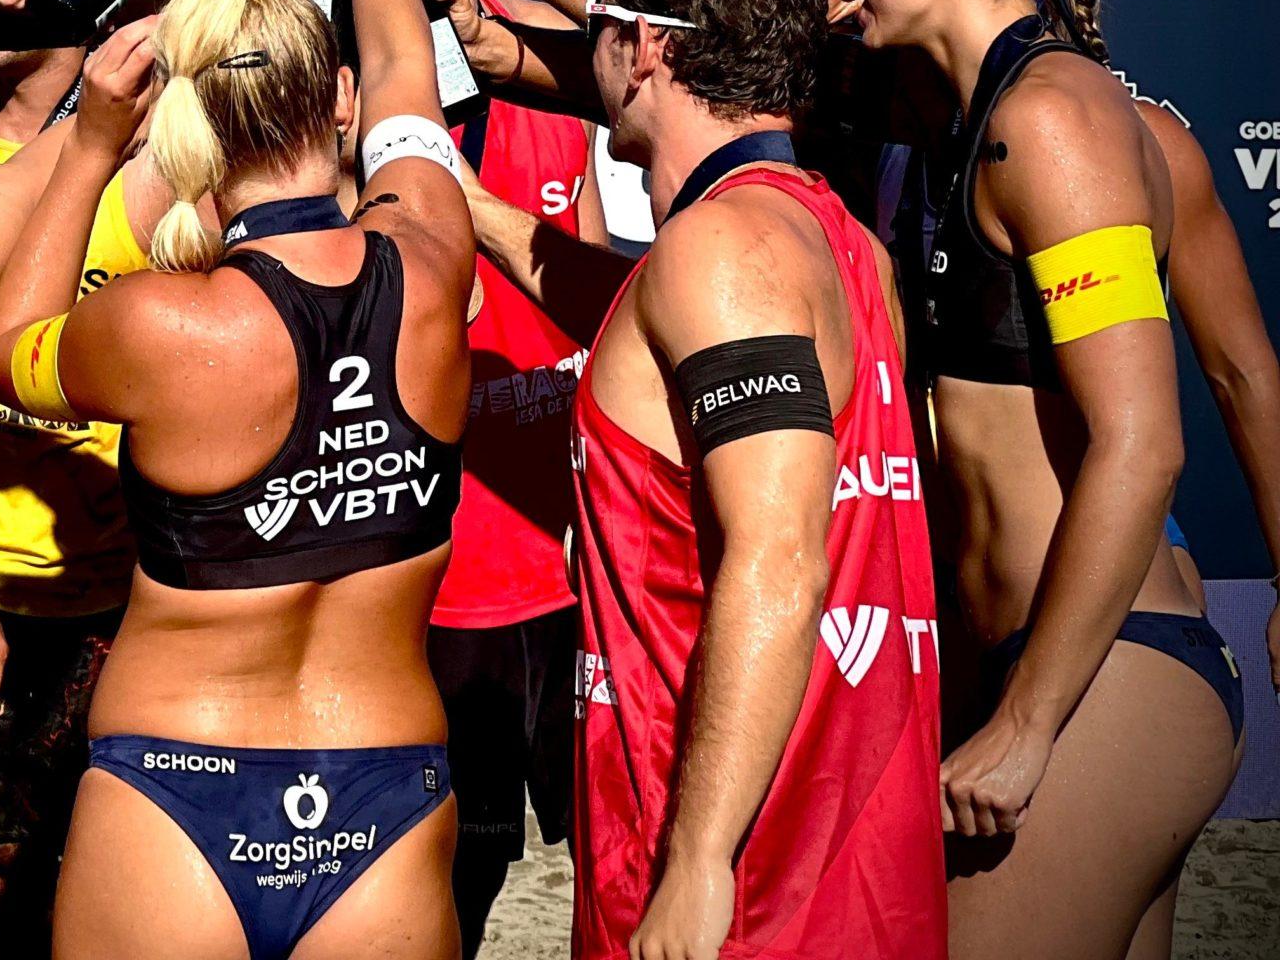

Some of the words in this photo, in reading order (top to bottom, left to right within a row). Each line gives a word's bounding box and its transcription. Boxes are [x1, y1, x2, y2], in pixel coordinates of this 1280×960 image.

[329, 356, 374, 412] 2
[703, 374, 801, 413] BELWAG
[318, 420, 389, 455] NED
[264, 446, 426, 500] SCHOON
[308, 473, 440, 527] VBTV
[143, 752, 236, 774] SCHOON
[256, 869, 307, 890] wegwijs
